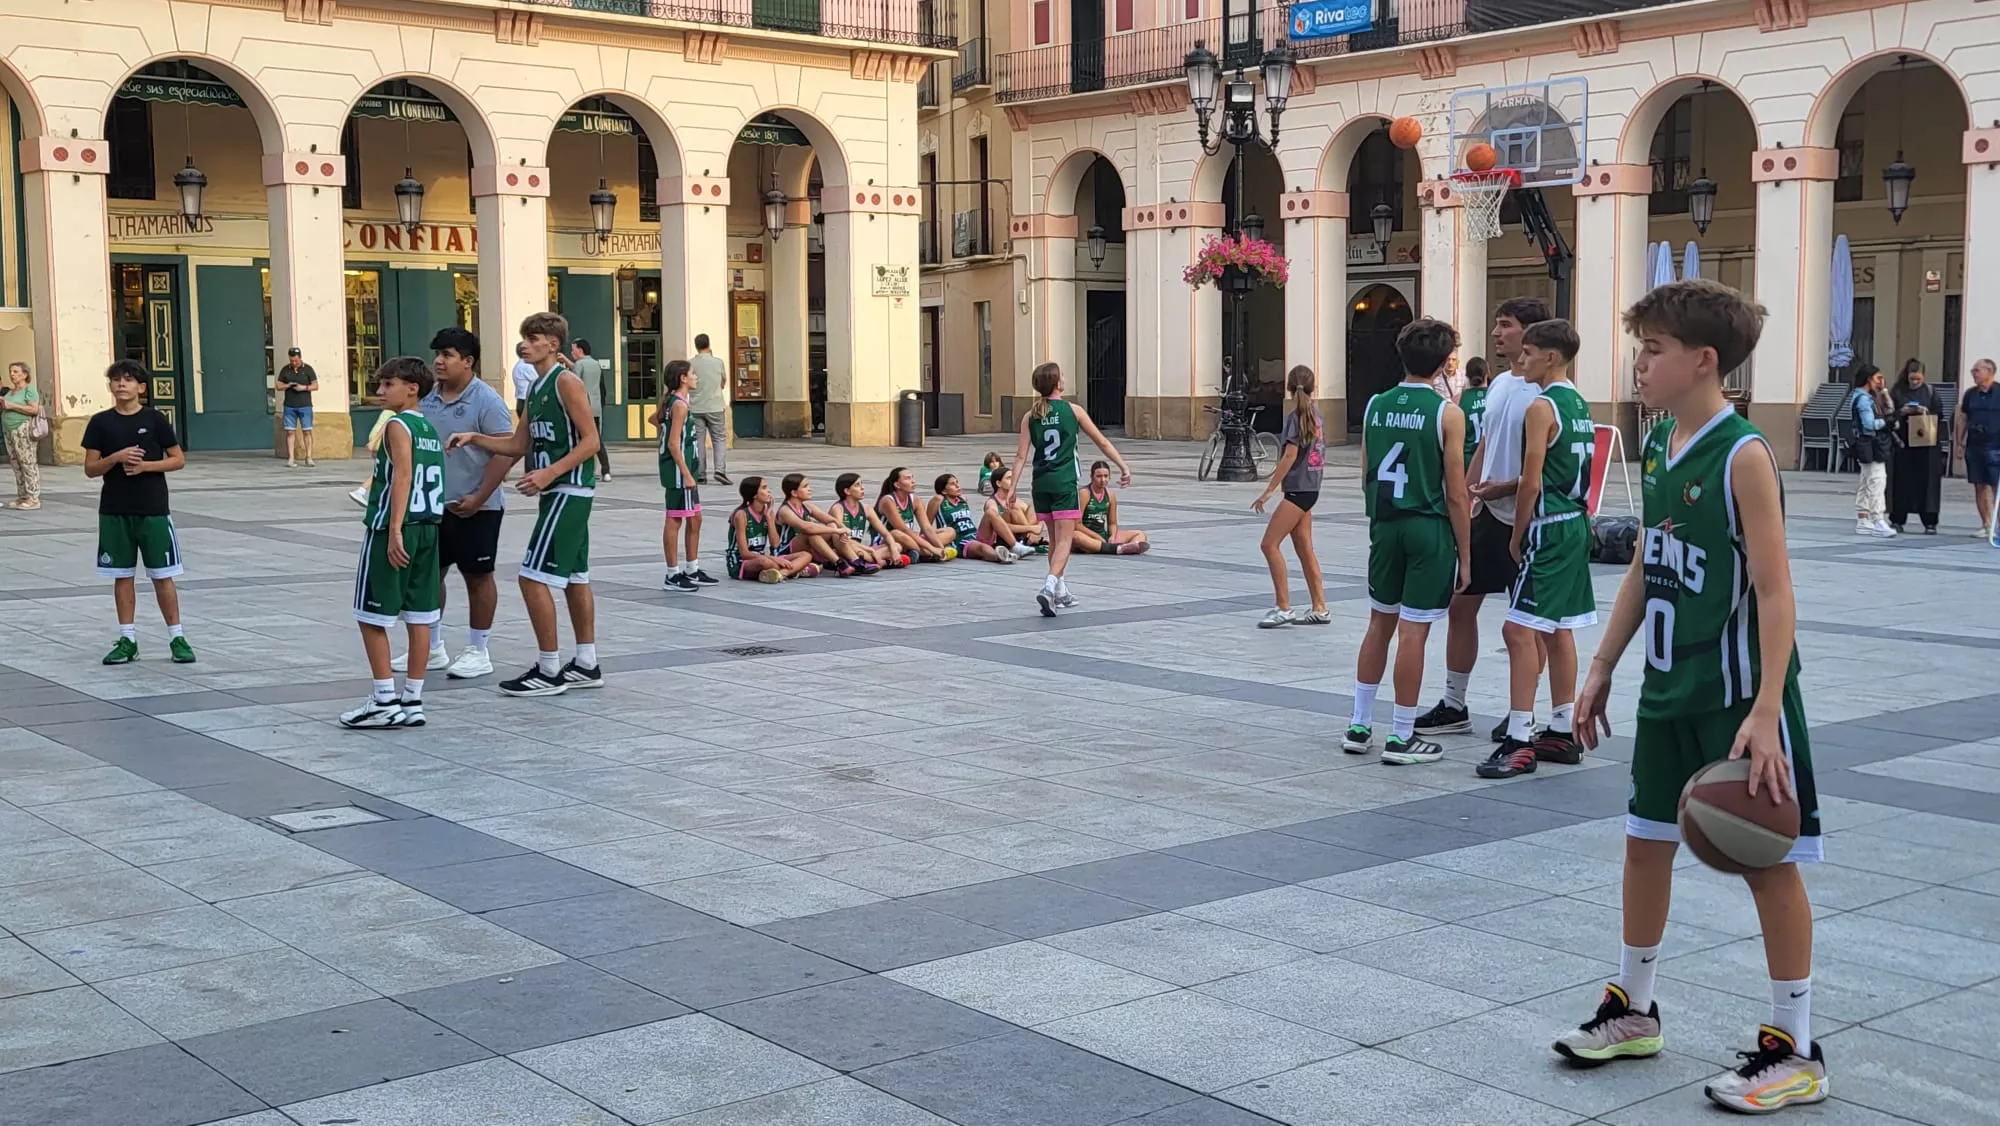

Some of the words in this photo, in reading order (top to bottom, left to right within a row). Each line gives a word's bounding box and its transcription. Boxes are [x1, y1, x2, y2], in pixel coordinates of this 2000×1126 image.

[1315, 5, 1367, 25] Rivatec
[146, 85, 164, 95] sus
[401, 102, 446, 120] CONFIANZA
[1041, 411, 1060, 426] CLOÉ
[1371, 411, 1382, 427] A.
[1385, 407, 1426, 431] RAMÓN
[1044, 428, 1060, 461] 2
[1377, 441, 1408, 498] 4
[410, 463, 444, 515] 82
[1645, 574, 1679, 589] HUESCA
[1645, 597, 1675, 673] 0
